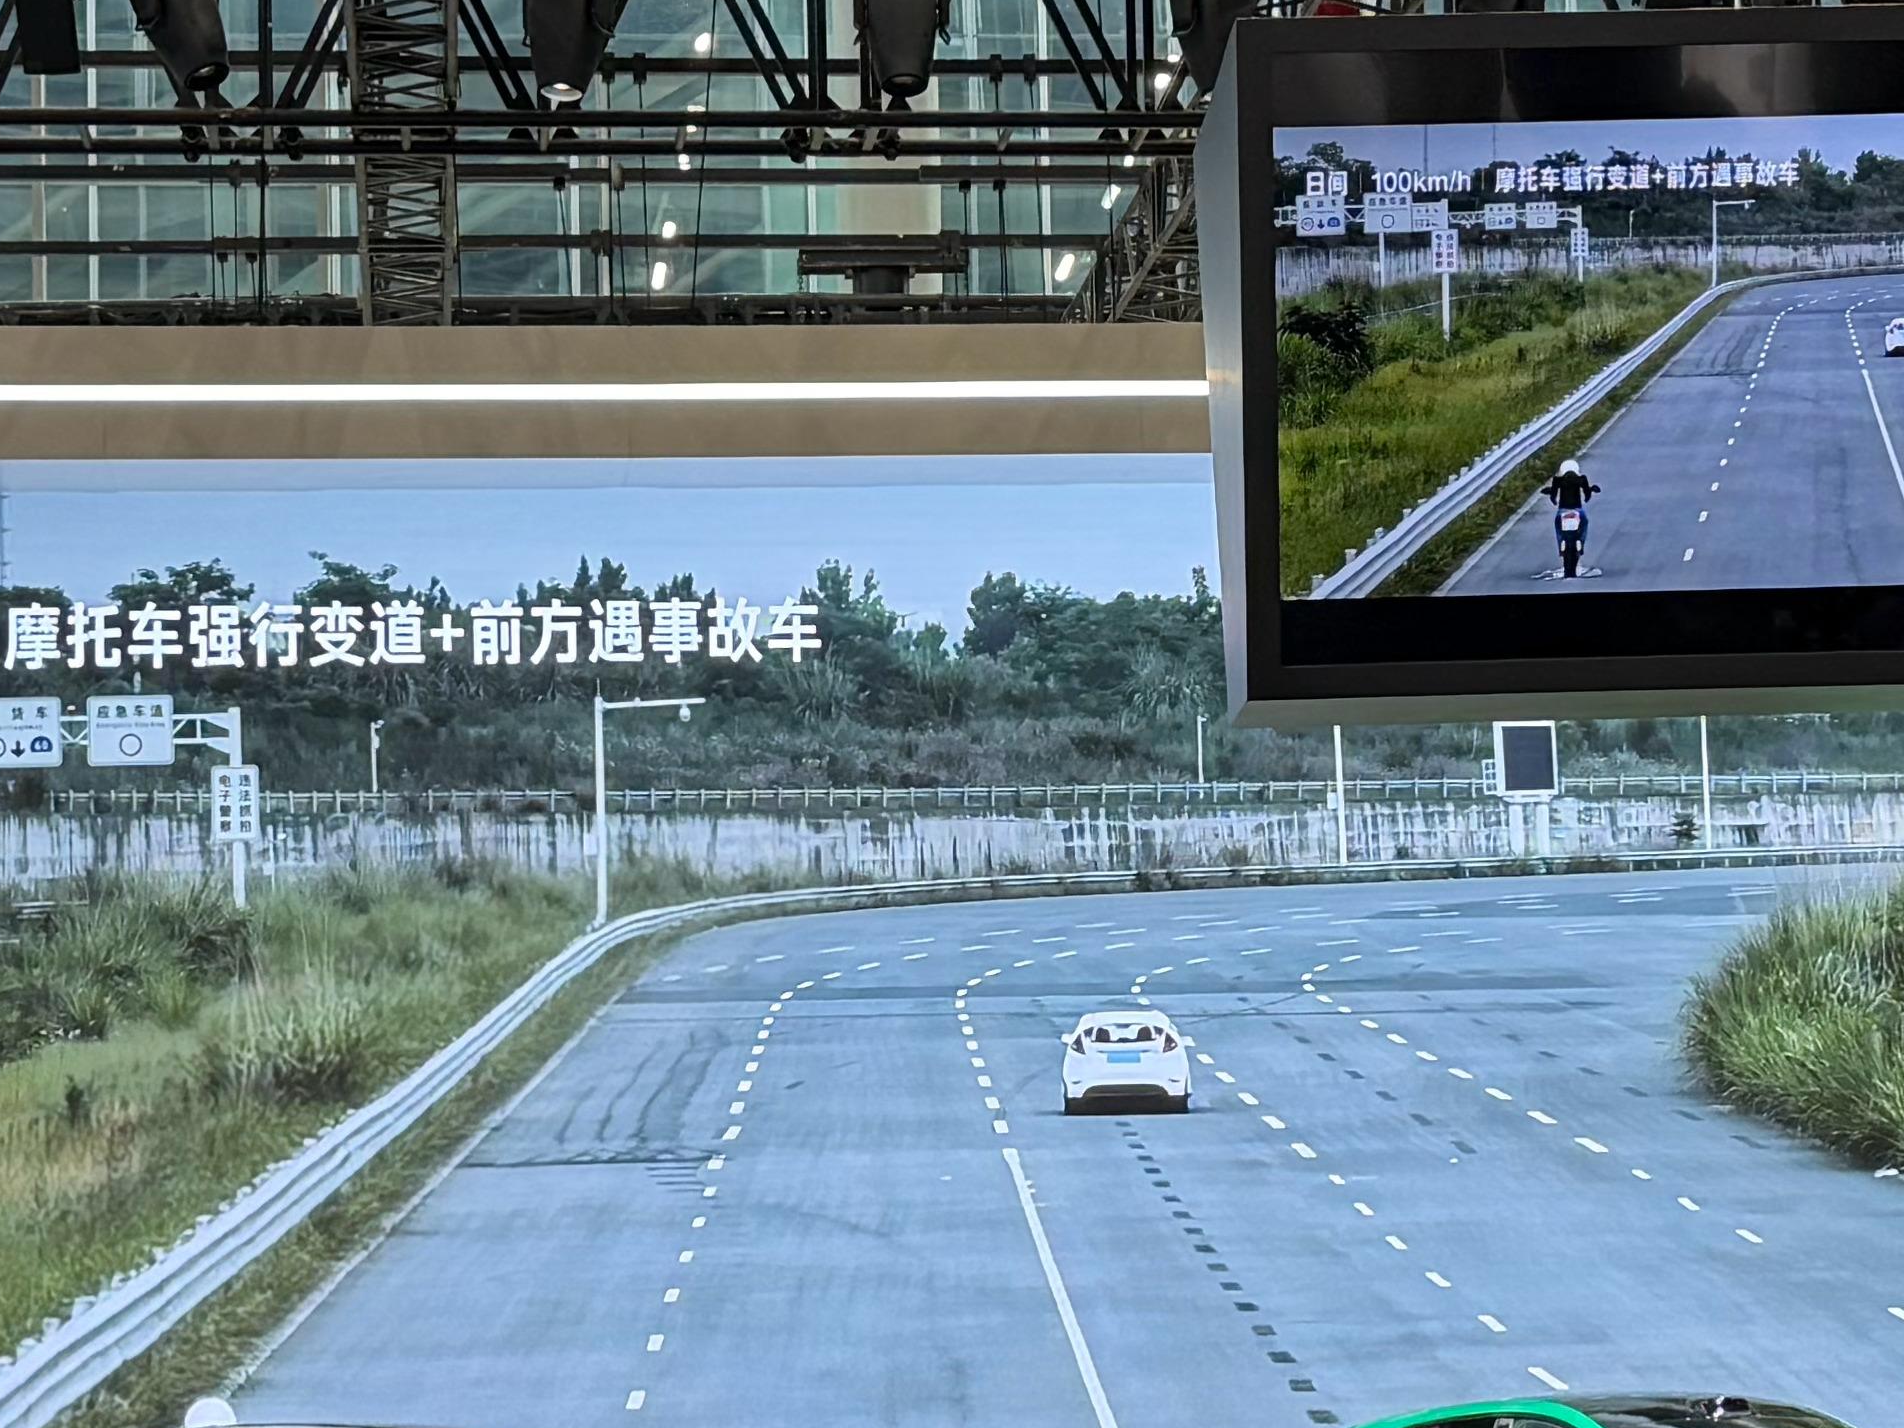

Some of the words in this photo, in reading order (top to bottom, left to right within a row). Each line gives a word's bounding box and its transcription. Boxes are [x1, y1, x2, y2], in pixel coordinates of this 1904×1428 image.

[1306, 171, 1348, 196] 日间
[1372, 171, 1471, 193] 100km/h
[3, 597, 823, 670] 摩托车强行变道+前方遇事故车
